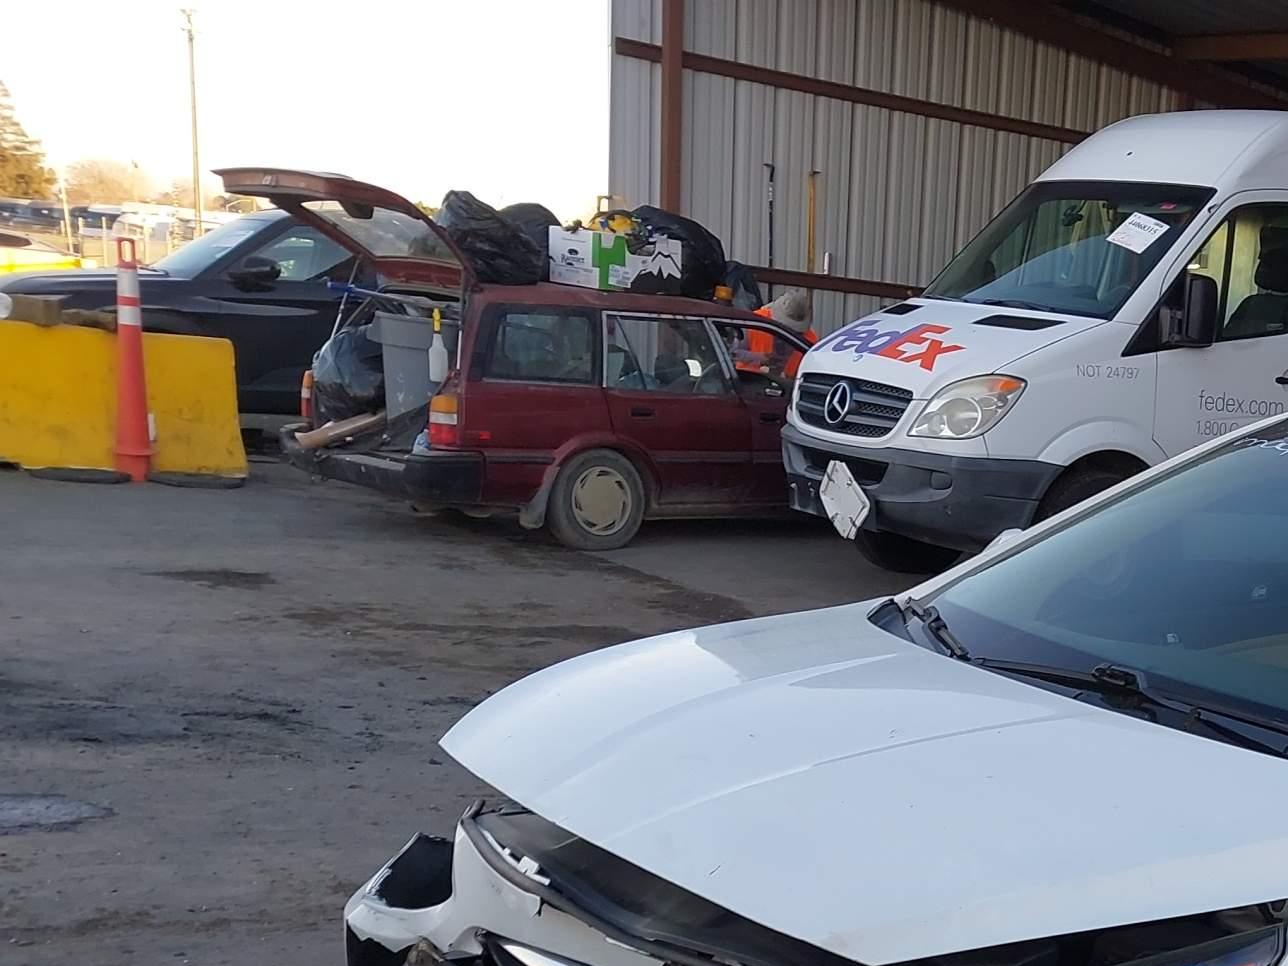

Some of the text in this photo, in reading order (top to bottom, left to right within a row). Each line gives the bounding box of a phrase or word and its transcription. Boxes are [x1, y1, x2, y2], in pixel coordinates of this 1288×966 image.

[811, 319, 967, 372] FedEx
[1076, 364, 1139, 380] NOT 24797
[1199, 390, 1284, 416] fedex.com
